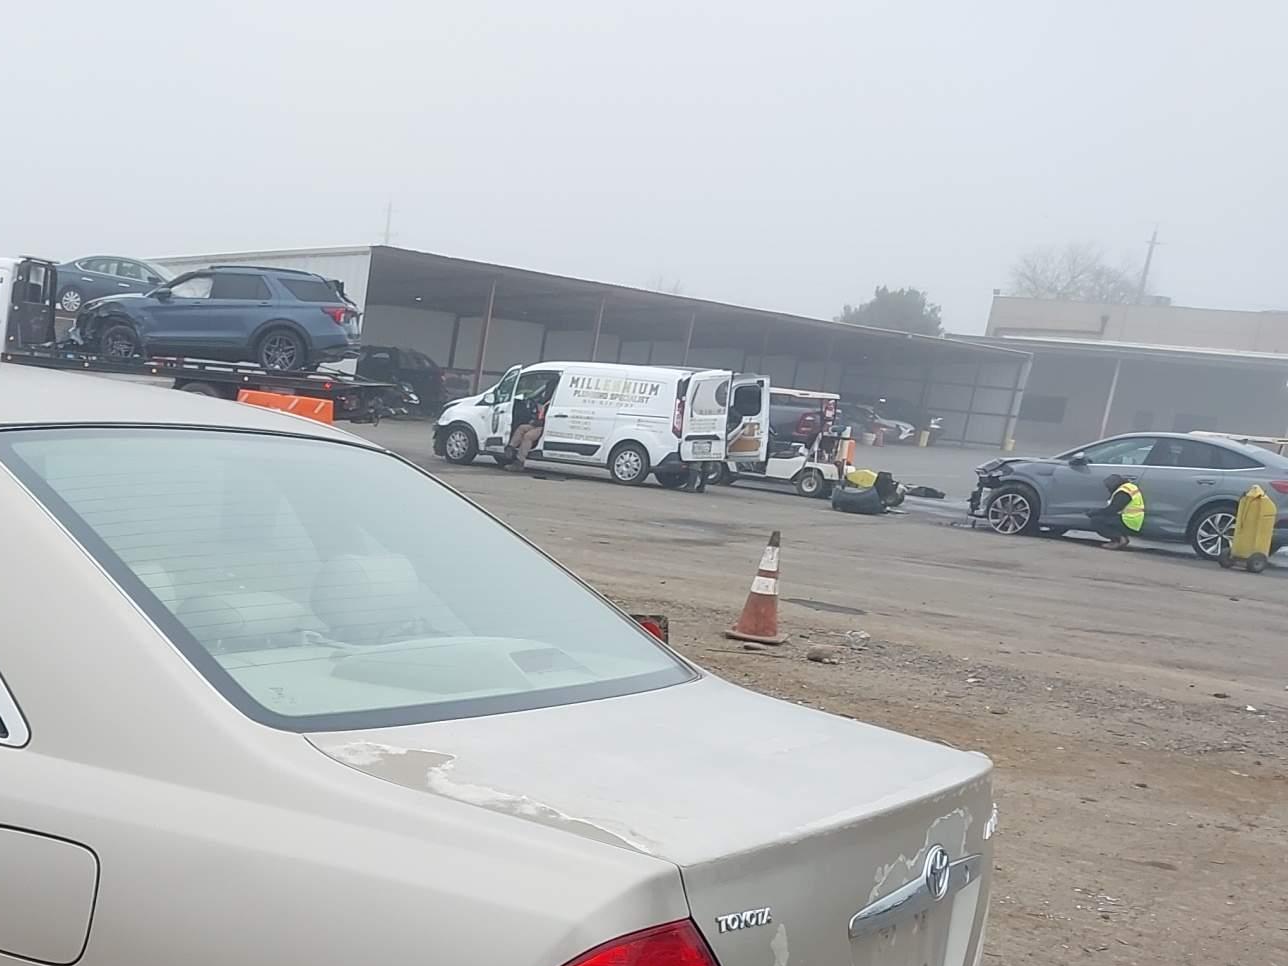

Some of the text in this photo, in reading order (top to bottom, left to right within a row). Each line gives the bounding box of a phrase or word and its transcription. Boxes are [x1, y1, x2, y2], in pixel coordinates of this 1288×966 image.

[569, 376, 660, 396] MILLENNIUM
[609, 392, 650, 405] SPECIALIST
[715, 907, 772, 933] TOYOTA
